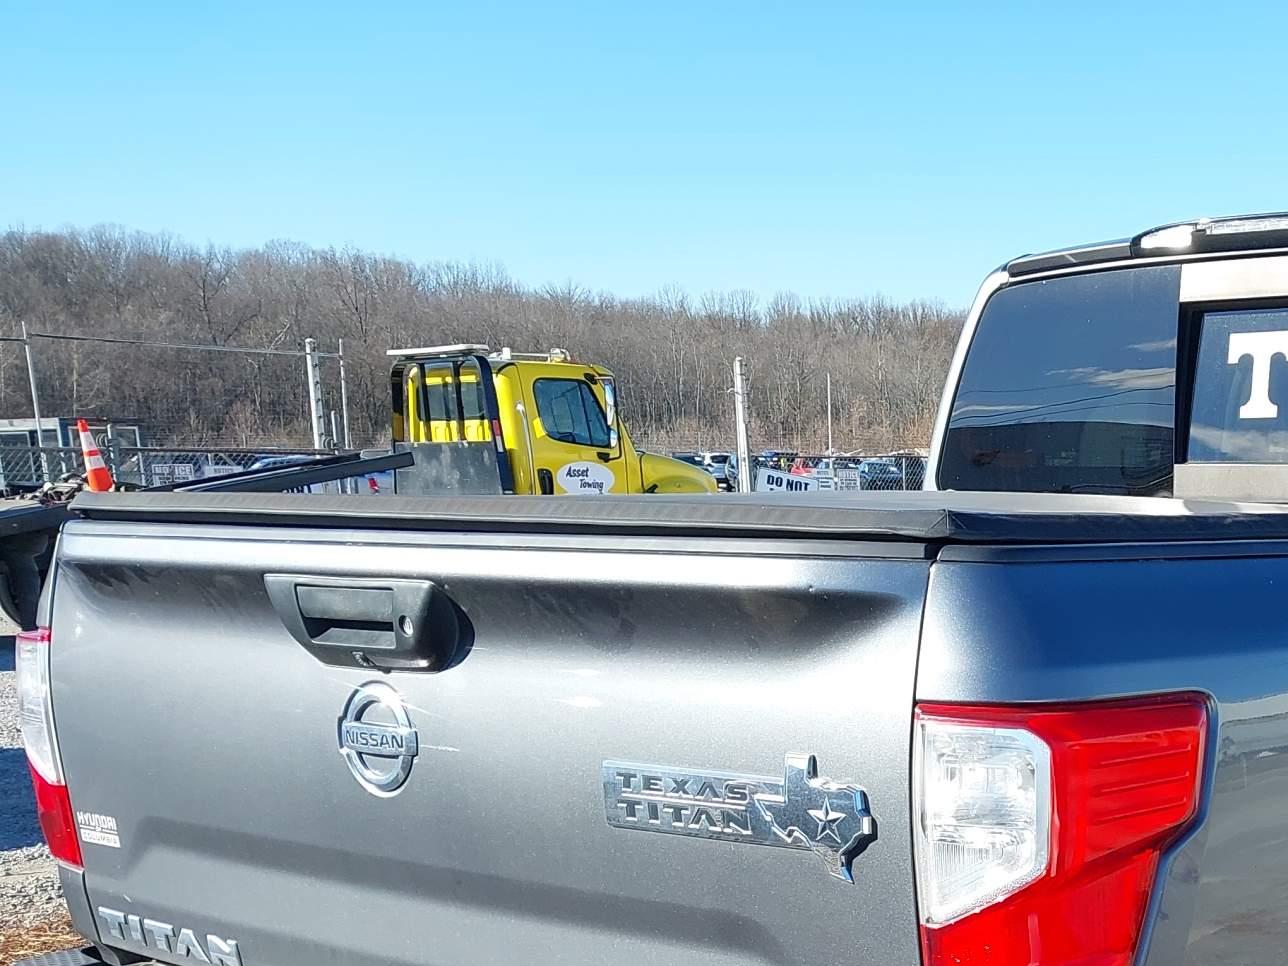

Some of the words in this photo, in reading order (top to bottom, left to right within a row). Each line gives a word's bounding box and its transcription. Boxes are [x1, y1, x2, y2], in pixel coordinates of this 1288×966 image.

[154, 466, 191, 475] NOICE
[565, 465, 589, 478] Asset
[579, 479, 604, 494] Towing
[766, 474, 783, 487] DO
[785, 478, 810, 492] NOT
[345, 729, 404, 749] NISSAN
[616, 771, 751, 802] TEXAS
[76, 810, 118, 831] HYUNDAI
[617, 799, 753, 835] TITAN
